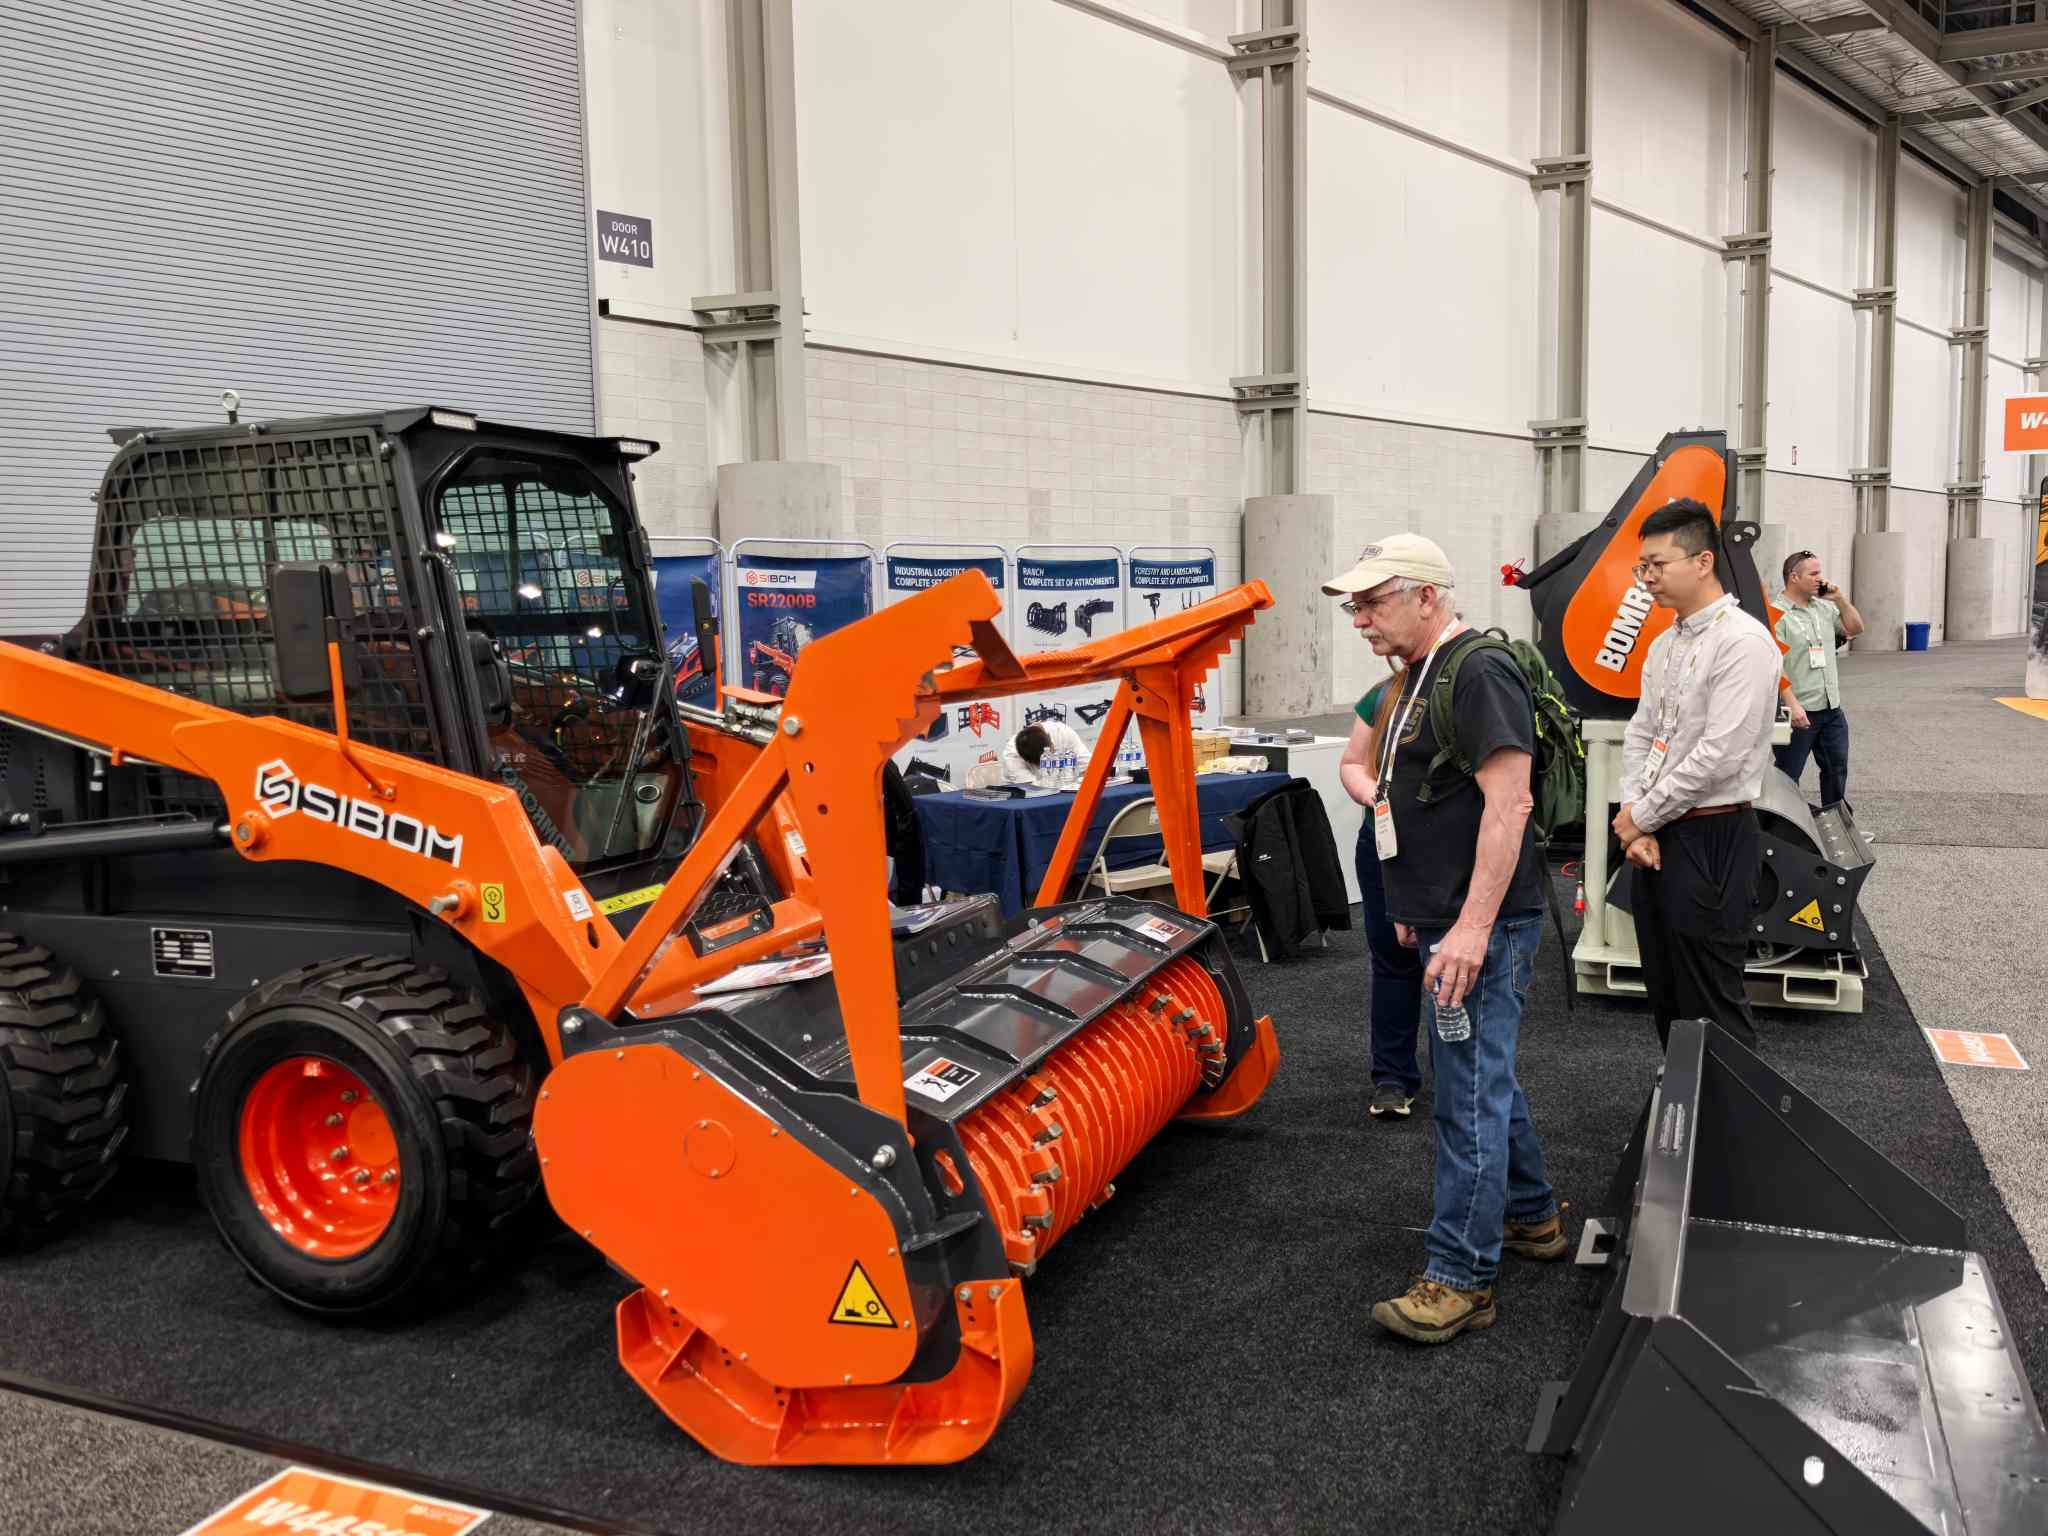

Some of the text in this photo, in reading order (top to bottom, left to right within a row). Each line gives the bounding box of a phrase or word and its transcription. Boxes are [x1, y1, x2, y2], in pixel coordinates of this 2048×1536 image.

[611, 221, 638, 235] DOOR
[601, 233, 650, 259] W410
[894, 566, 933, 577] INDUSTRIAL
[1022, 567, 1045, 577] RANCH
[1134, 566, 1202, 576] FORESTRY AND LANDSCAPING
[759, 574, 797, 584] SIBOM
[895, 577, 930, 588] COMPLETE
[1023, 576, 1115, 587] COMPLETE SET OF ATTACHMENTS
[1134, 575, 1209, 585] COMPLETE SET OF ATTACHMENTS
[747, 592, 817, 609] SR2200B
[1595, 582, 1656, 673] BOMR
[302, 783, 464, 869] SIBOM
